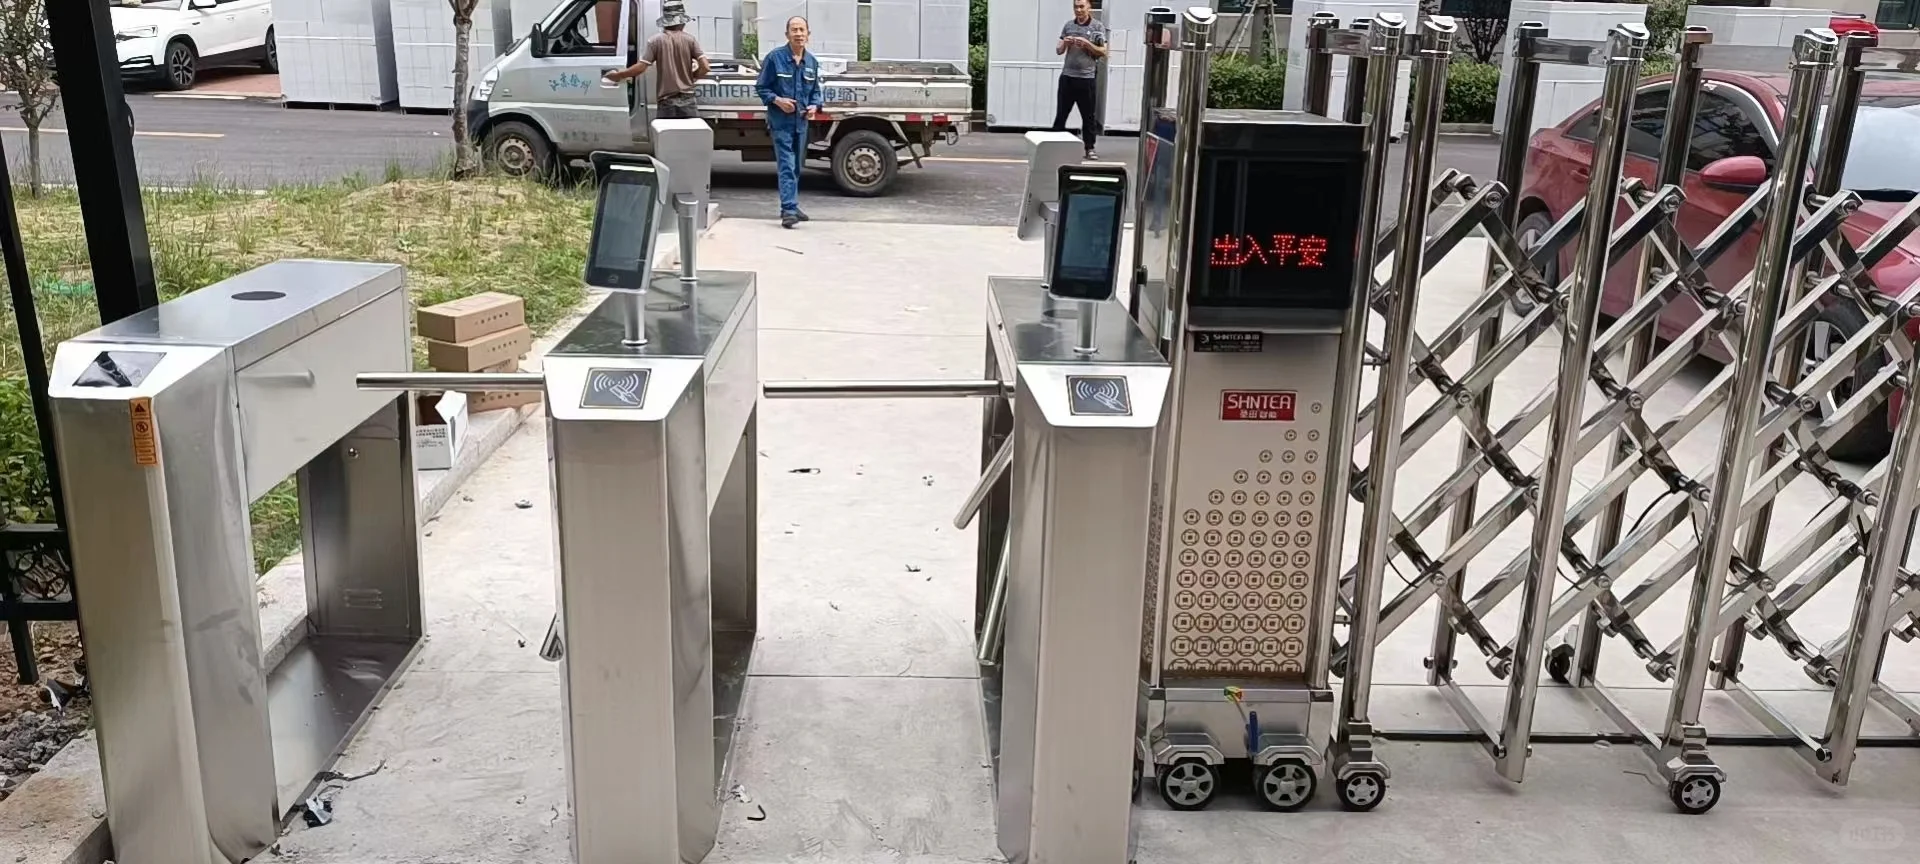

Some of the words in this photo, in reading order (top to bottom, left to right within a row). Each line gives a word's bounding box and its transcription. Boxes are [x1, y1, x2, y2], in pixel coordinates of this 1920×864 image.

[1210, 233, 1328, 267] 出入平安
[1227, 394, 1292, 409] SHNTEA
